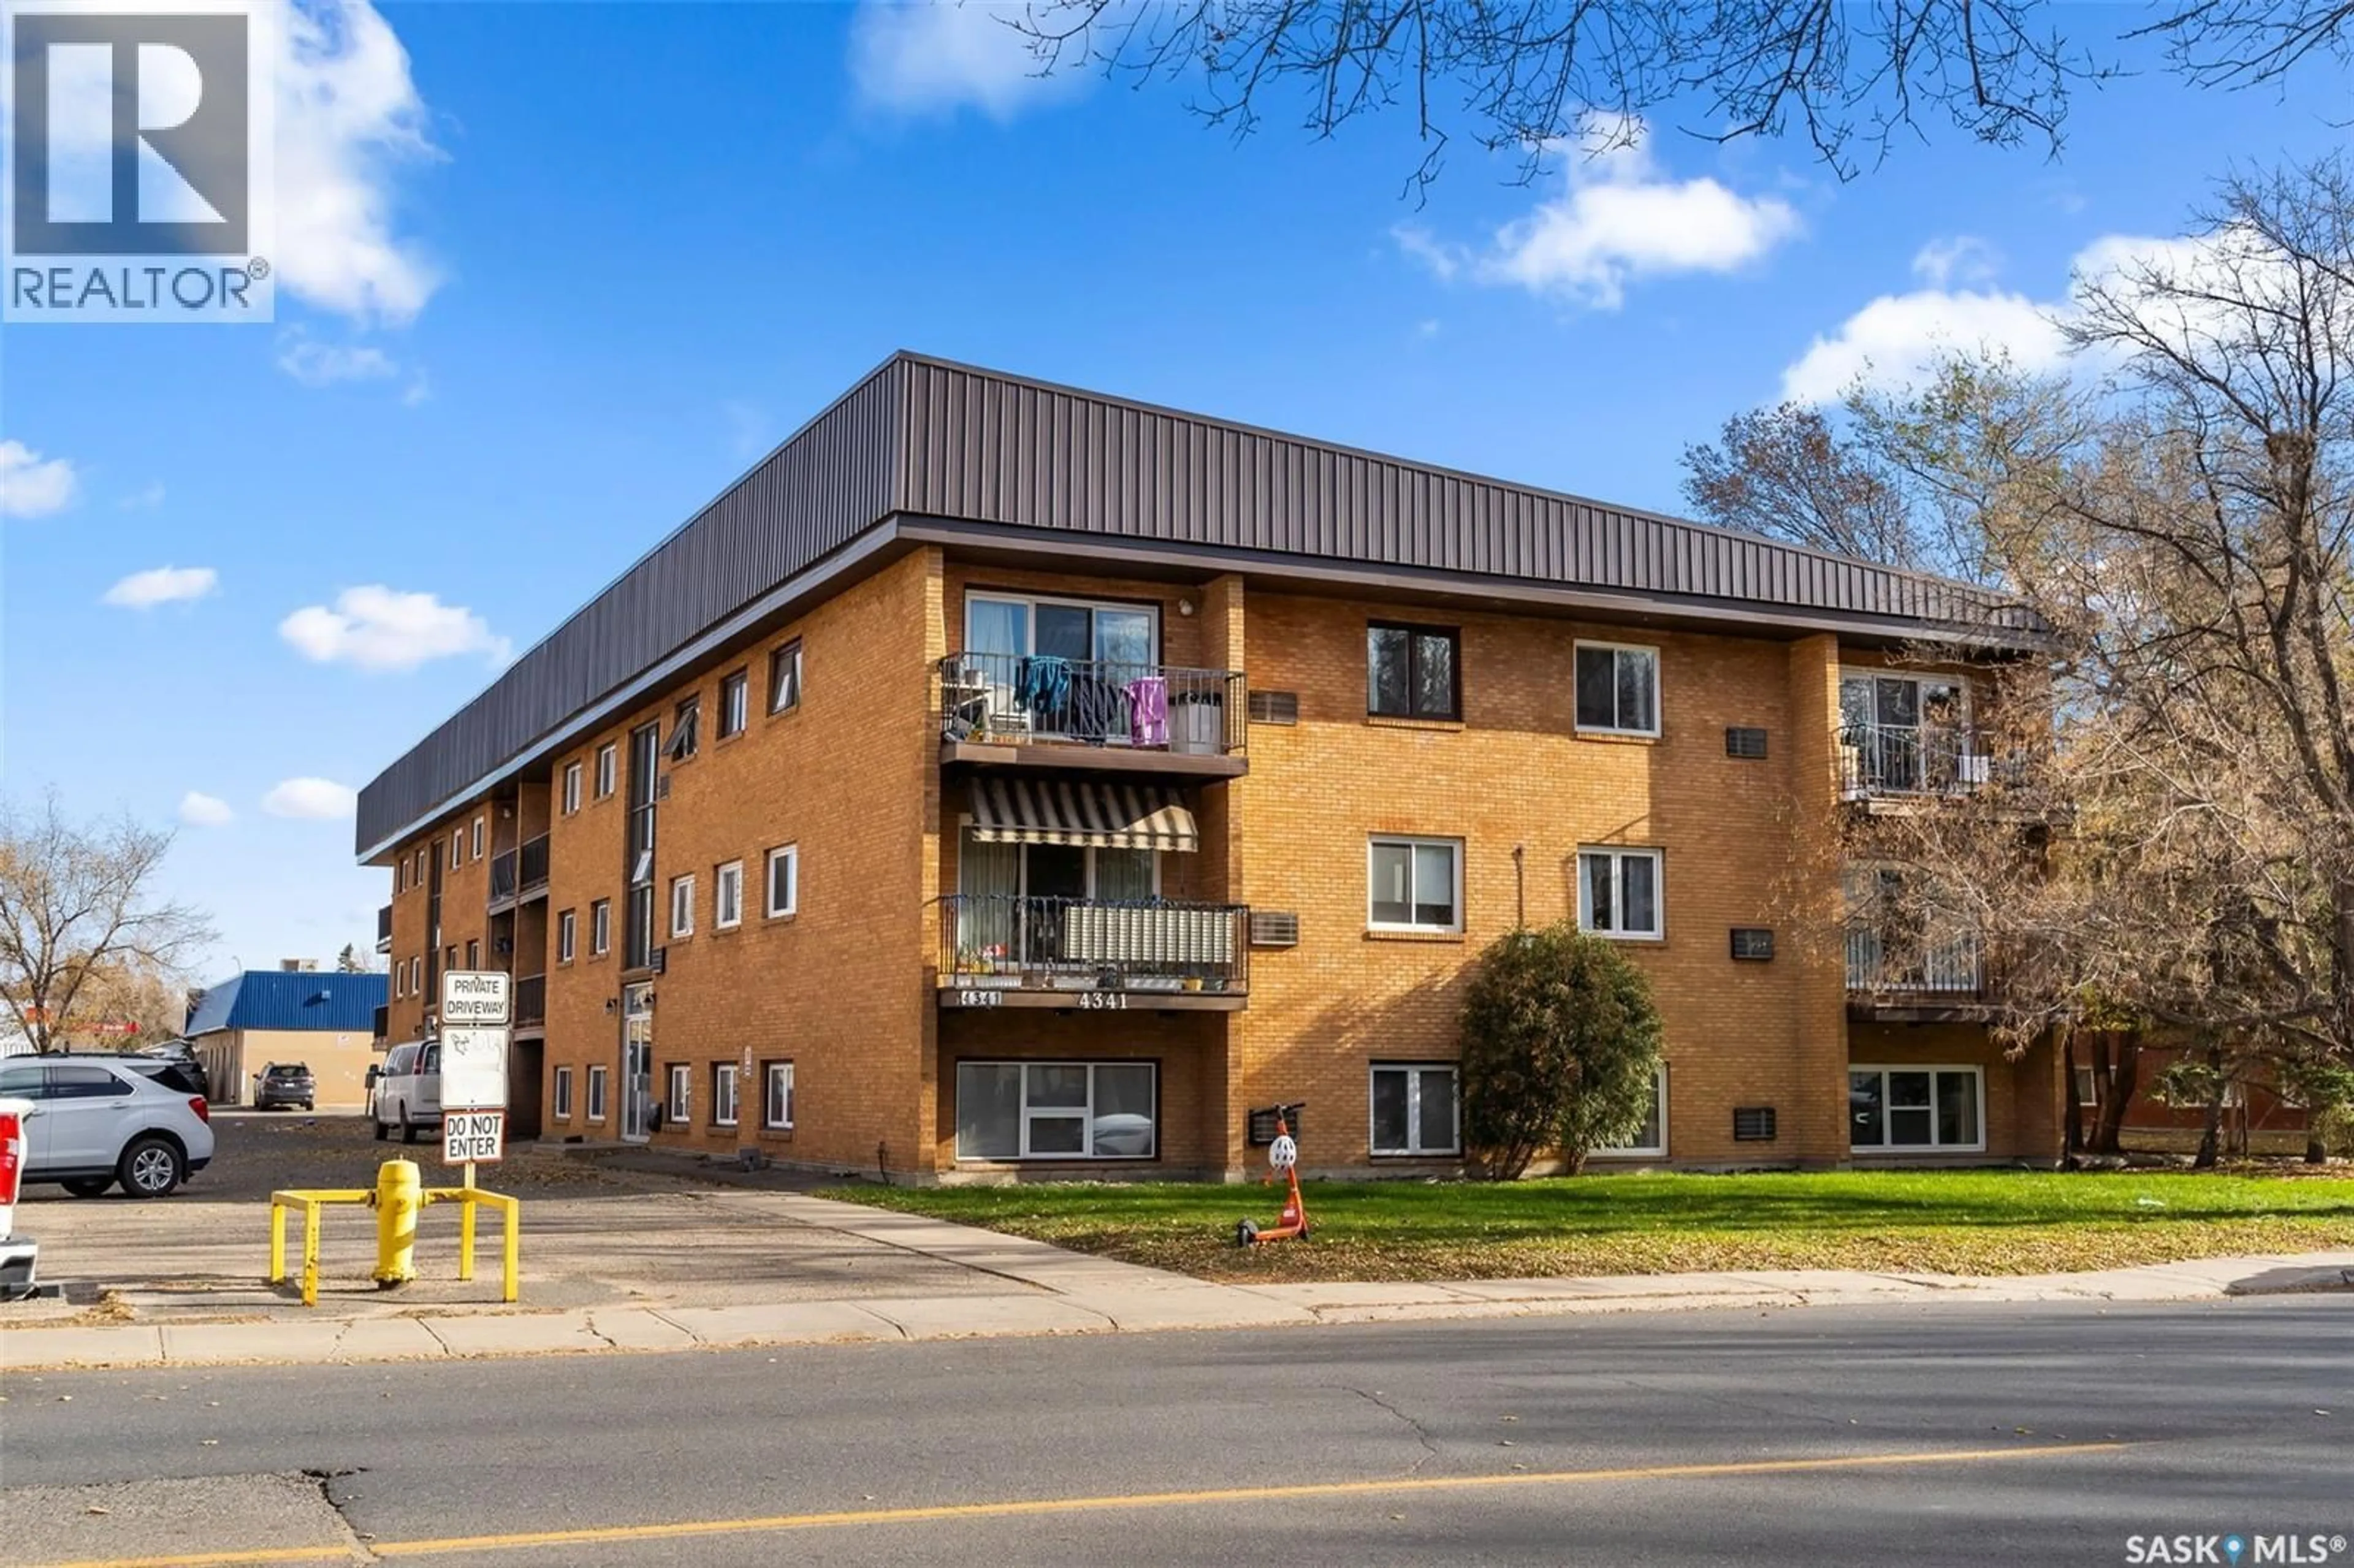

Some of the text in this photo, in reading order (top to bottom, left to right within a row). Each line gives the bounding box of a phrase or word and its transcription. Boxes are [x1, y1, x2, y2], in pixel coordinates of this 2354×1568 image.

[454, 980, 499, 994] PRIVATE
[447, 1000, 505, 1014] DRIVEWAY
[1079, 992, 1128, 1009] 4341
[447, 1116, 501, 1136] DO NOT
[449, 1138, 496, 1157] ENTER
